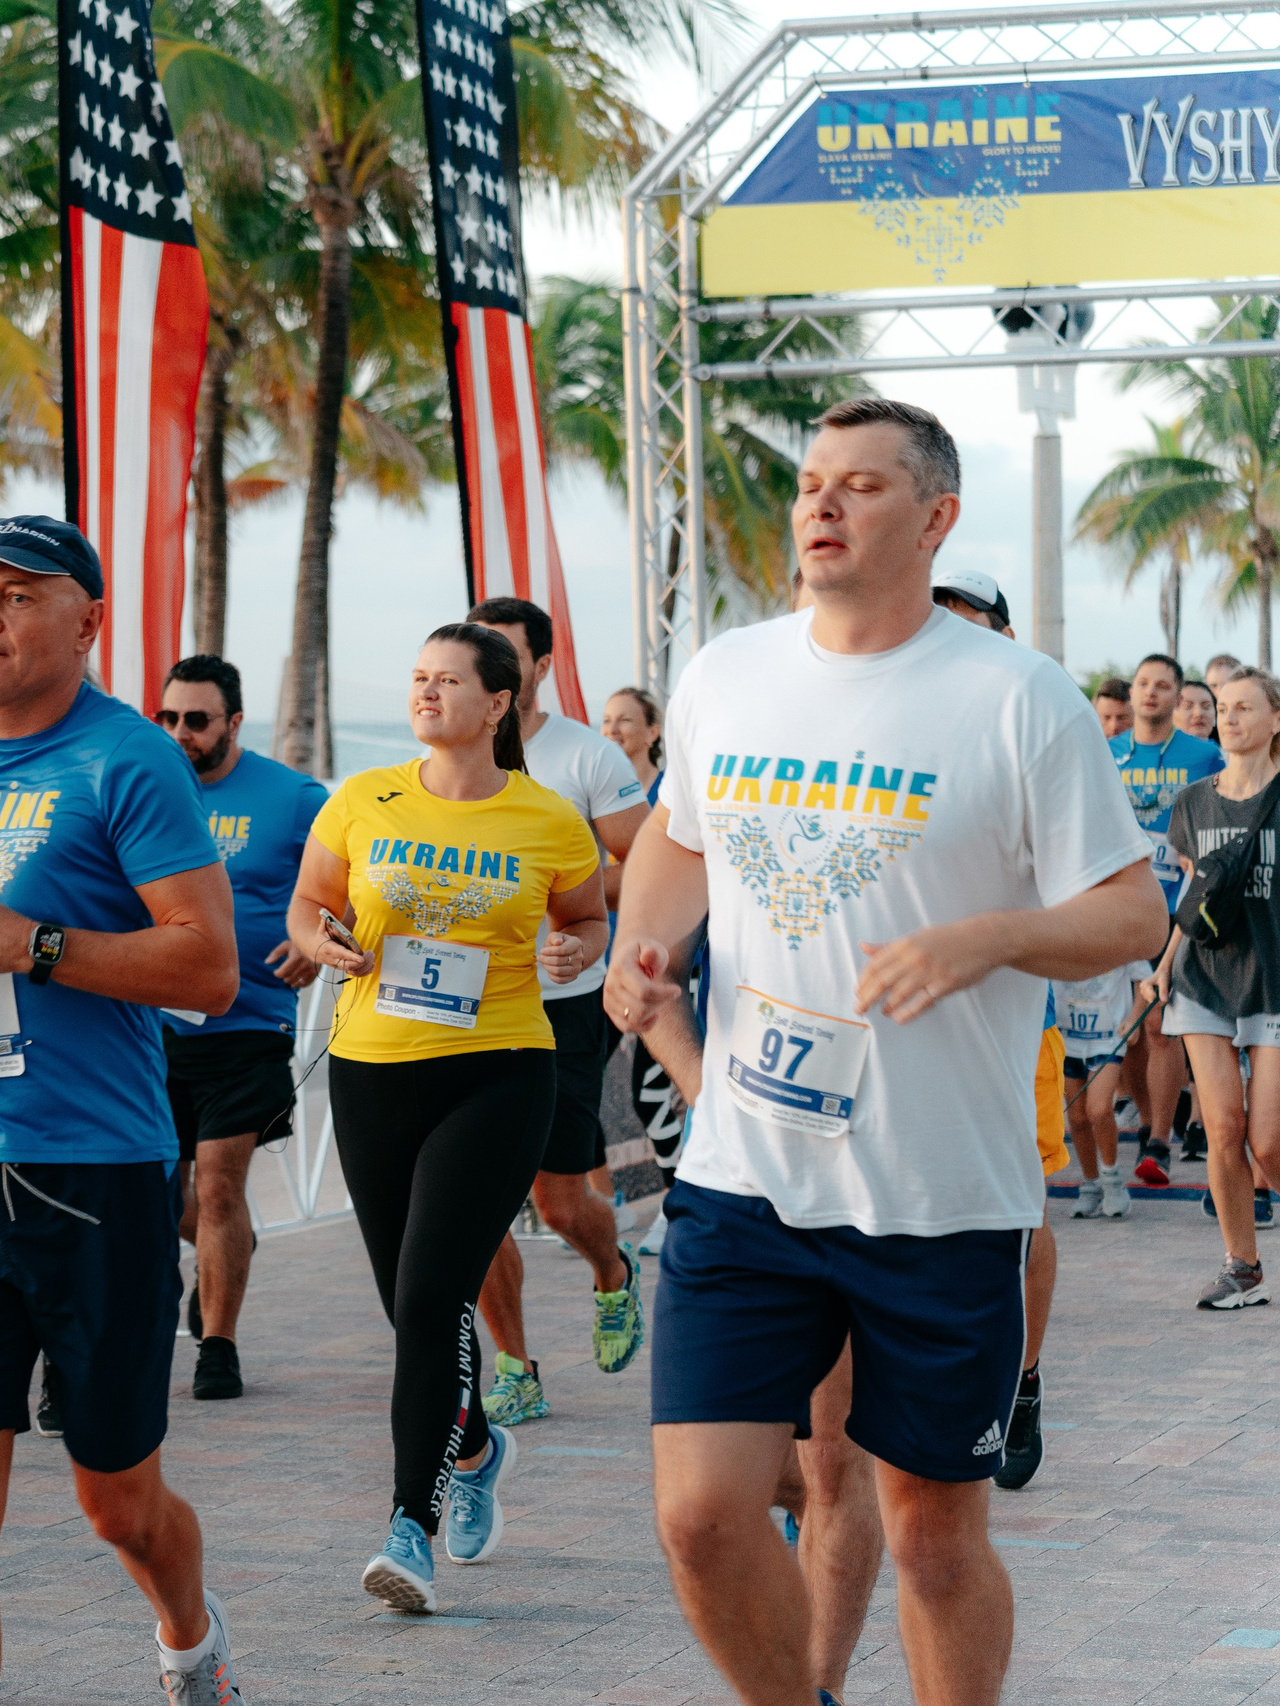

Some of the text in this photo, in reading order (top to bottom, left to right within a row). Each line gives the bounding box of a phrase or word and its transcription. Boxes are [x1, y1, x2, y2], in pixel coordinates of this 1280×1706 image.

[817, 86, 1062, 152] UKRAINE
[706, 750, 938, 823] UKRAINE
[368, 838, 521, 883] UKRAINE
[421, 957, 442, 990] 5
[1070, 1012, 1098, 1031] 107
[758, 1028, 814, 1081] 97
[458, 1301, 476, 1390] TOMMY
[429, 1424, 465, 1518] HILFIGER
[972, 1438, 1003, 1456] adidas
